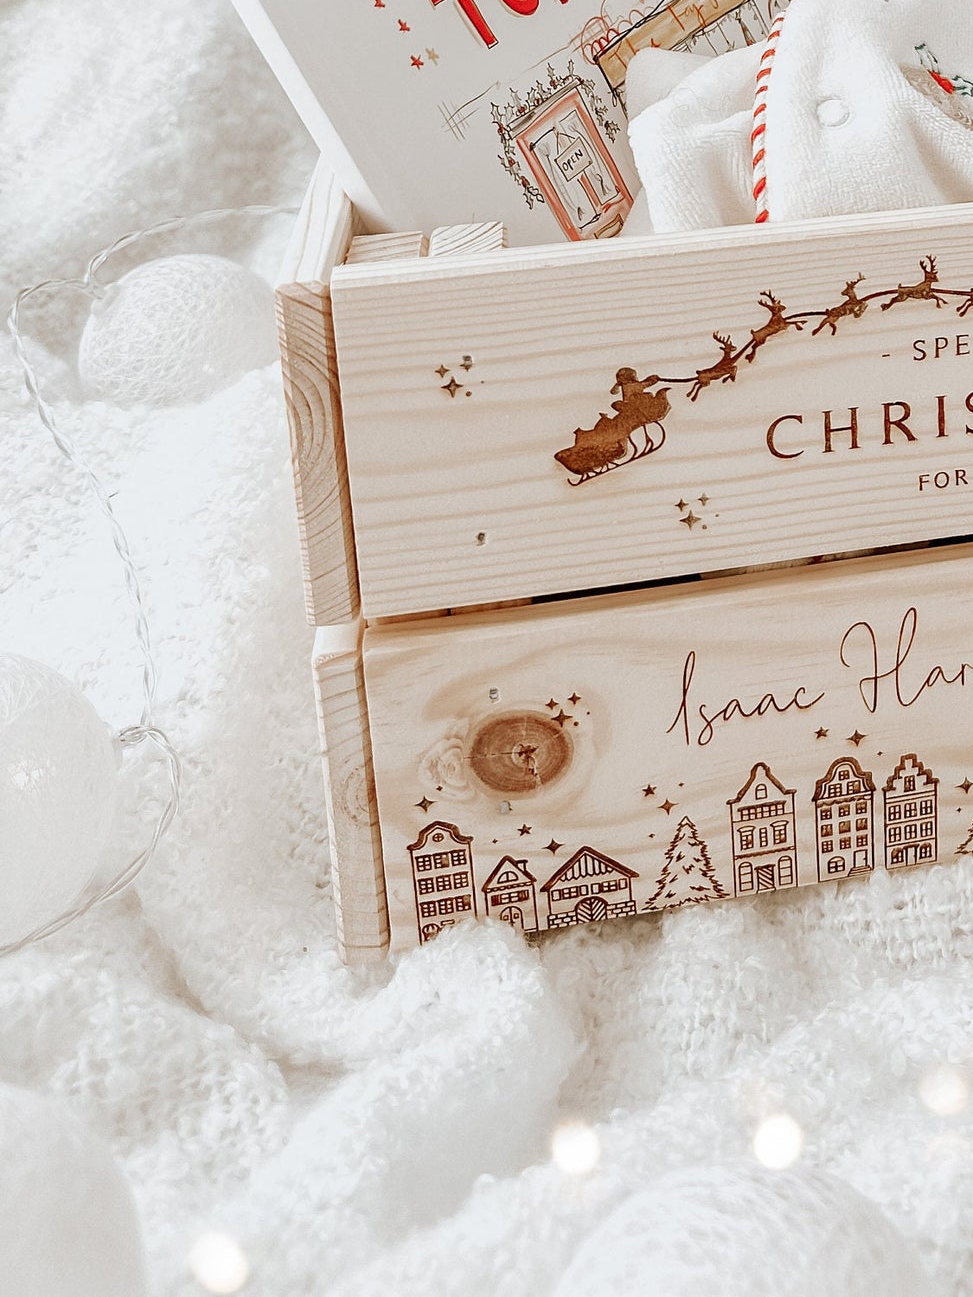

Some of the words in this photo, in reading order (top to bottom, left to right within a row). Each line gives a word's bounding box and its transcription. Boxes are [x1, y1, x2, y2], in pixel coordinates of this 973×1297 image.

[561, 148, 584, 172] OPEN
[917, 468, 969, 492] FOR
[664, 649, 826, 748] Isaac
